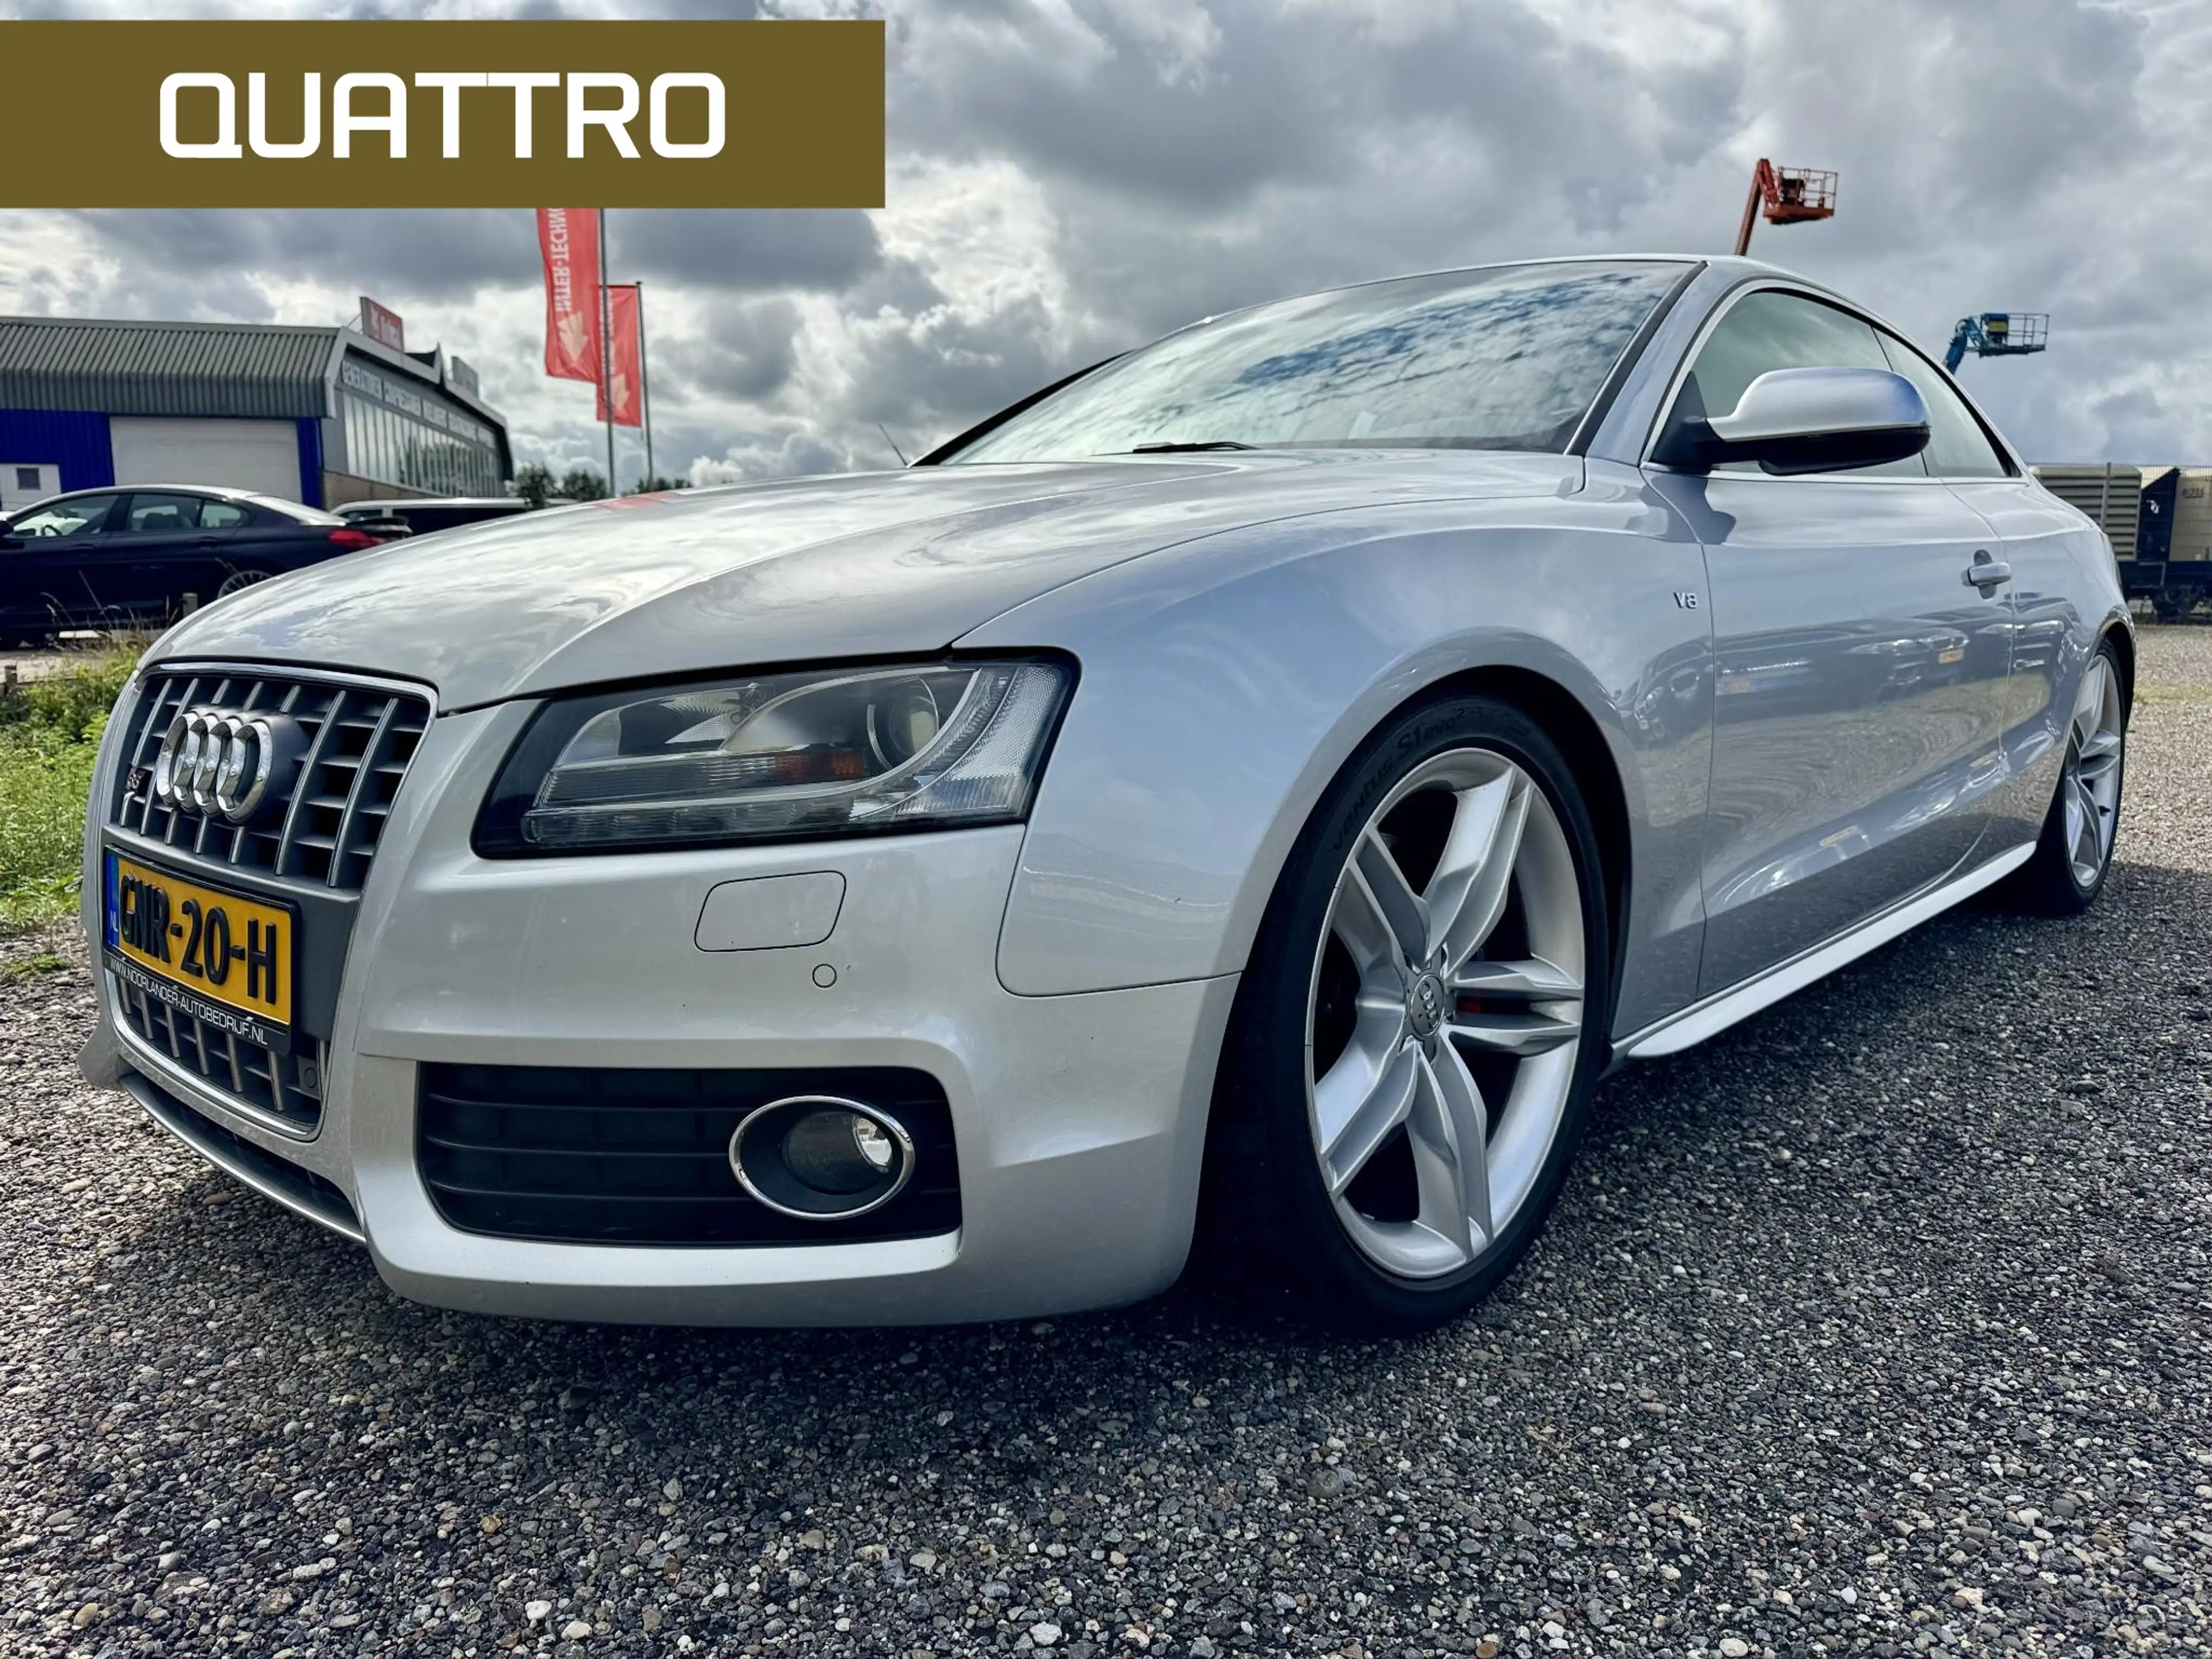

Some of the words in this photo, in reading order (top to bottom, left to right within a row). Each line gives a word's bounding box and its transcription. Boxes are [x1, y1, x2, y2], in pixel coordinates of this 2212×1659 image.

[1673, 591, 1698, 609] V8
[109, 910, 119, 932] NL
[120, 873, 277, 1006] GNR-20-H
[109, 956, 268, 1045] WWW.NOORLANDER-AUTOBEDRIJF.NL
